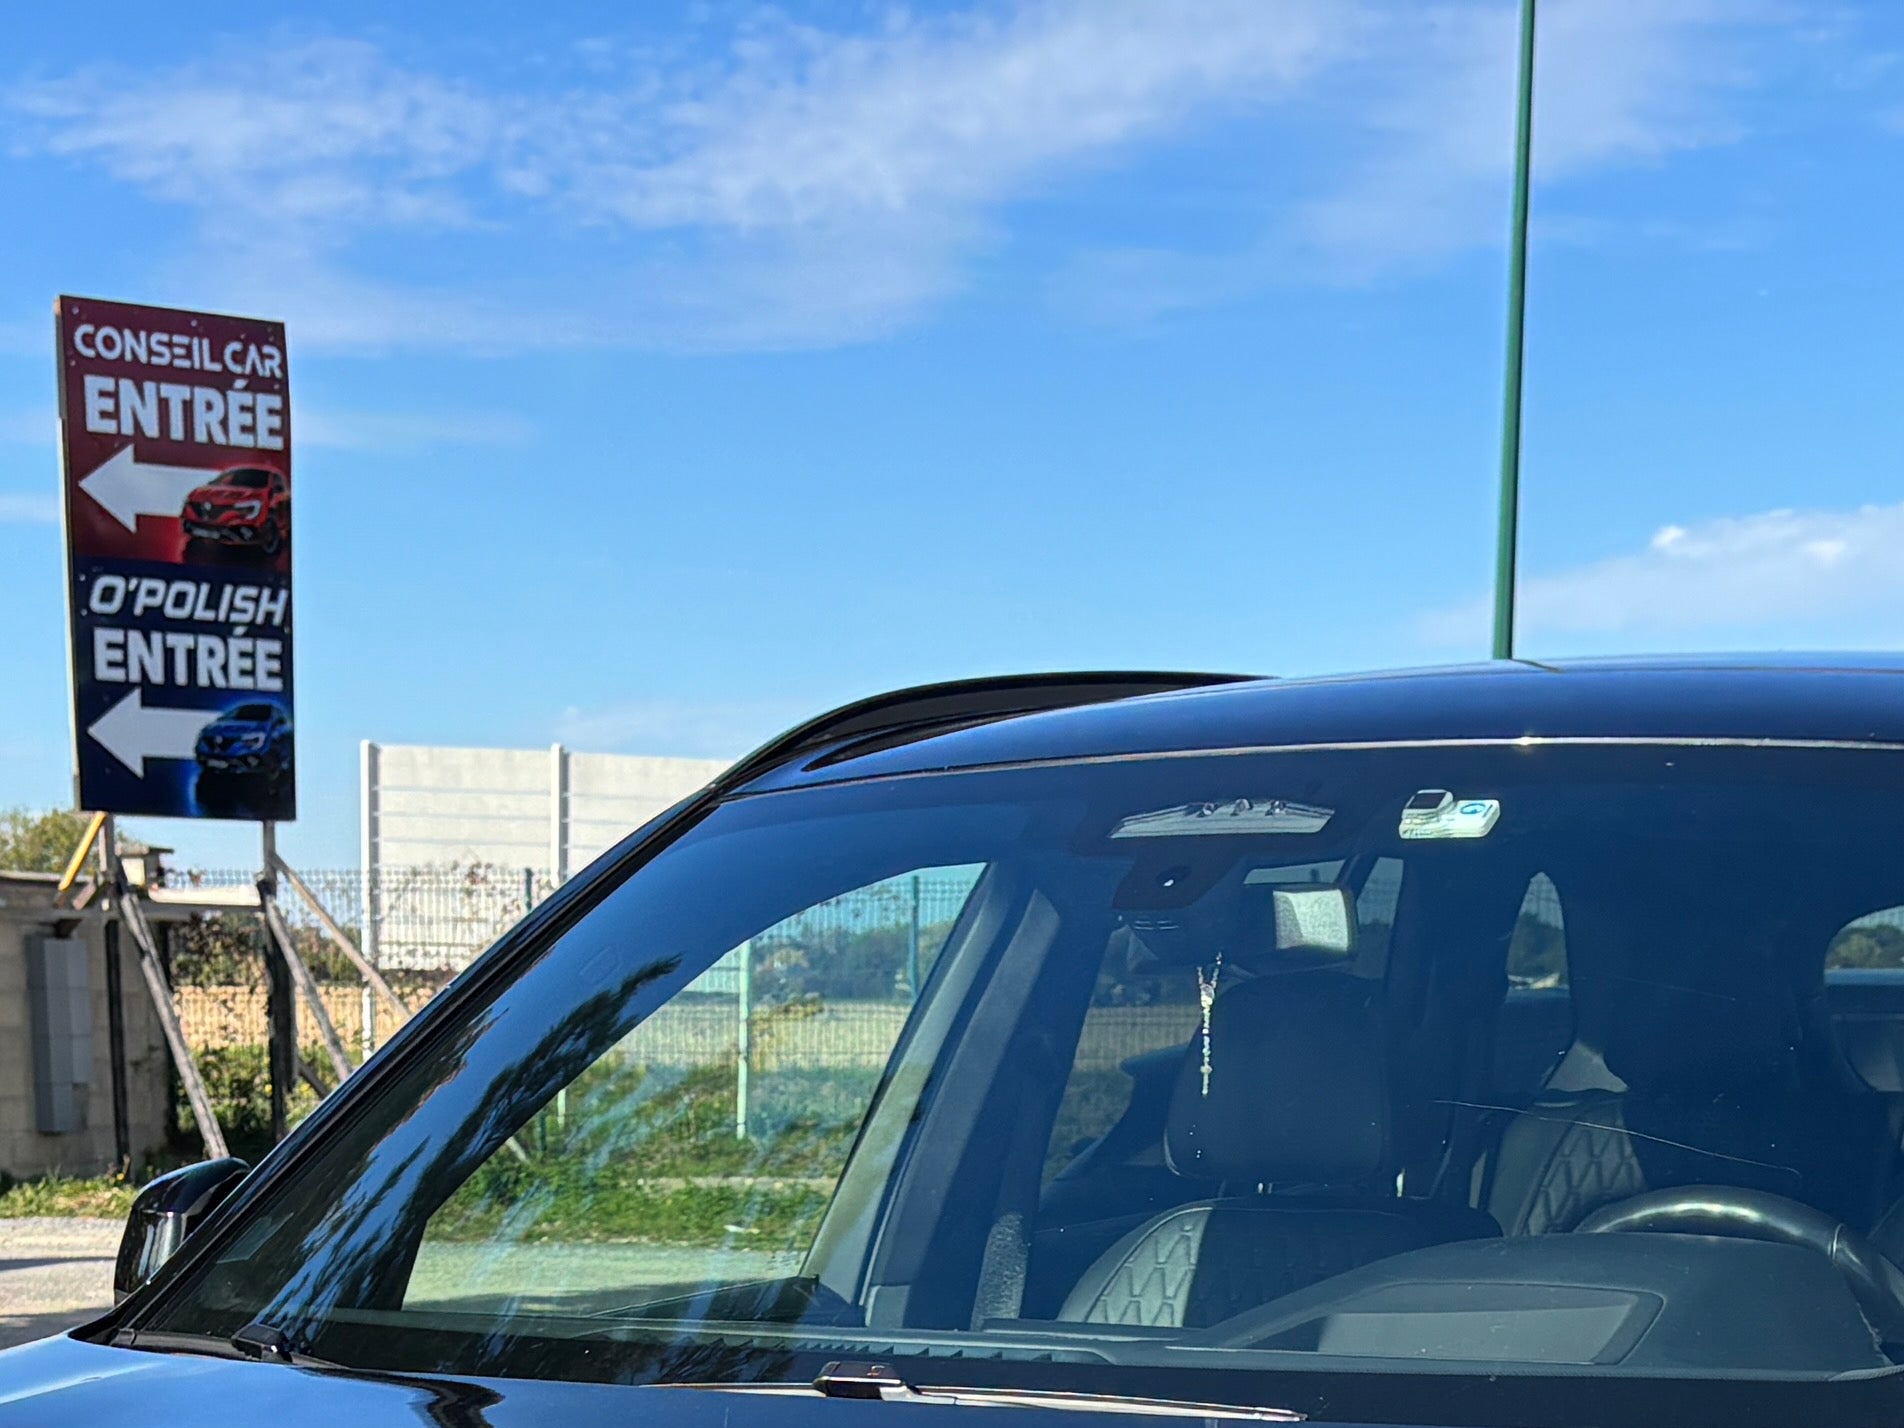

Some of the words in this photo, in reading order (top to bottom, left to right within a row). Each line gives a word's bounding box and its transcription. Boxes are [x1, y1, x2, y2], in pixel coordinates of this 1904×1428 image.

[83, 373, 284, 451] ENTRÉE
[89, 573, 289, 626] O'POLISH
[93, 625, 284, 693] ENTRÉE
